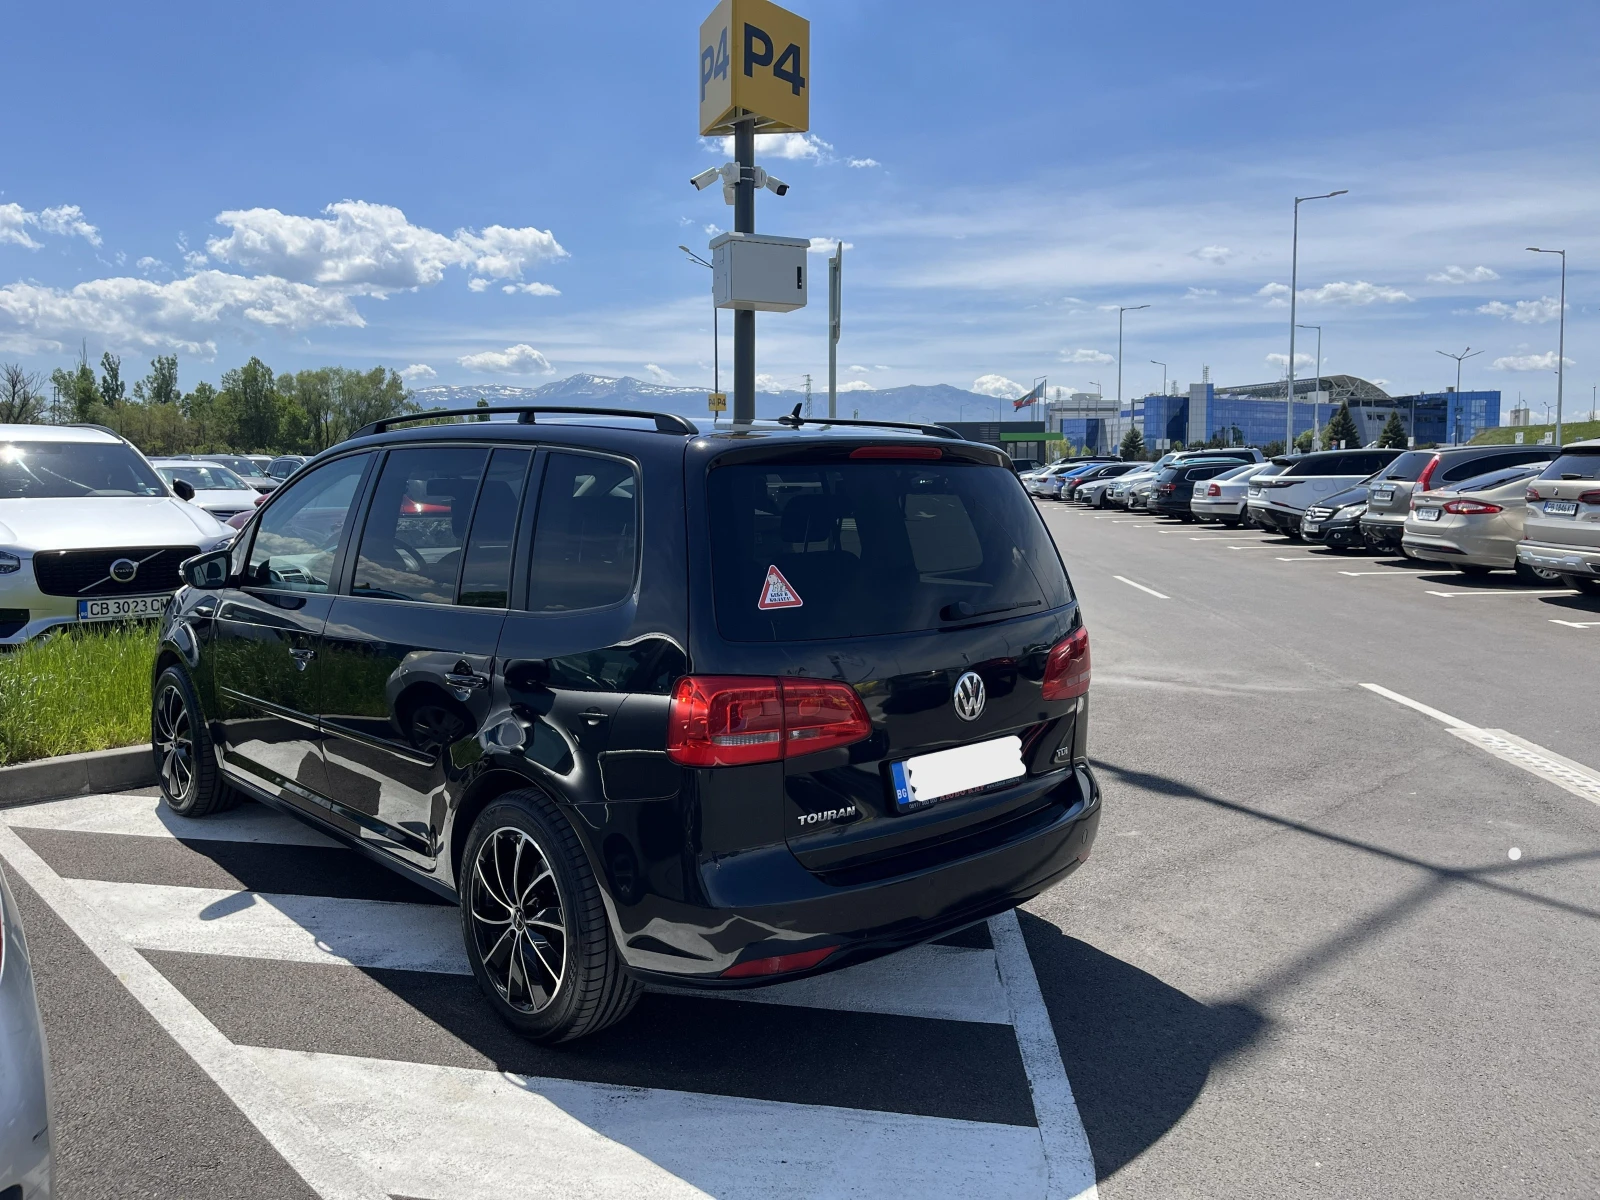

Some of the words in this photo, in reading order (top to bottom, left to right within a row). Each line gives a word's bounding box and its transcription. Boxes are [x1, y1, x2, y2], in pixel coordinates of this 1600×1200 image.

[701, 26, 729, 103] P4
[744, 22, 805, 97] P4
[709, 398, 715, 406] P4
[717, 398, 726, 406] P4
[90, 602, 110, 616] CB
[113, 599, 148, 614] 3023
[1056, 746, 1068, 758] TDI
[897, 788, 908, 800] BG
[797, 805, 856, 826] TOURAN
